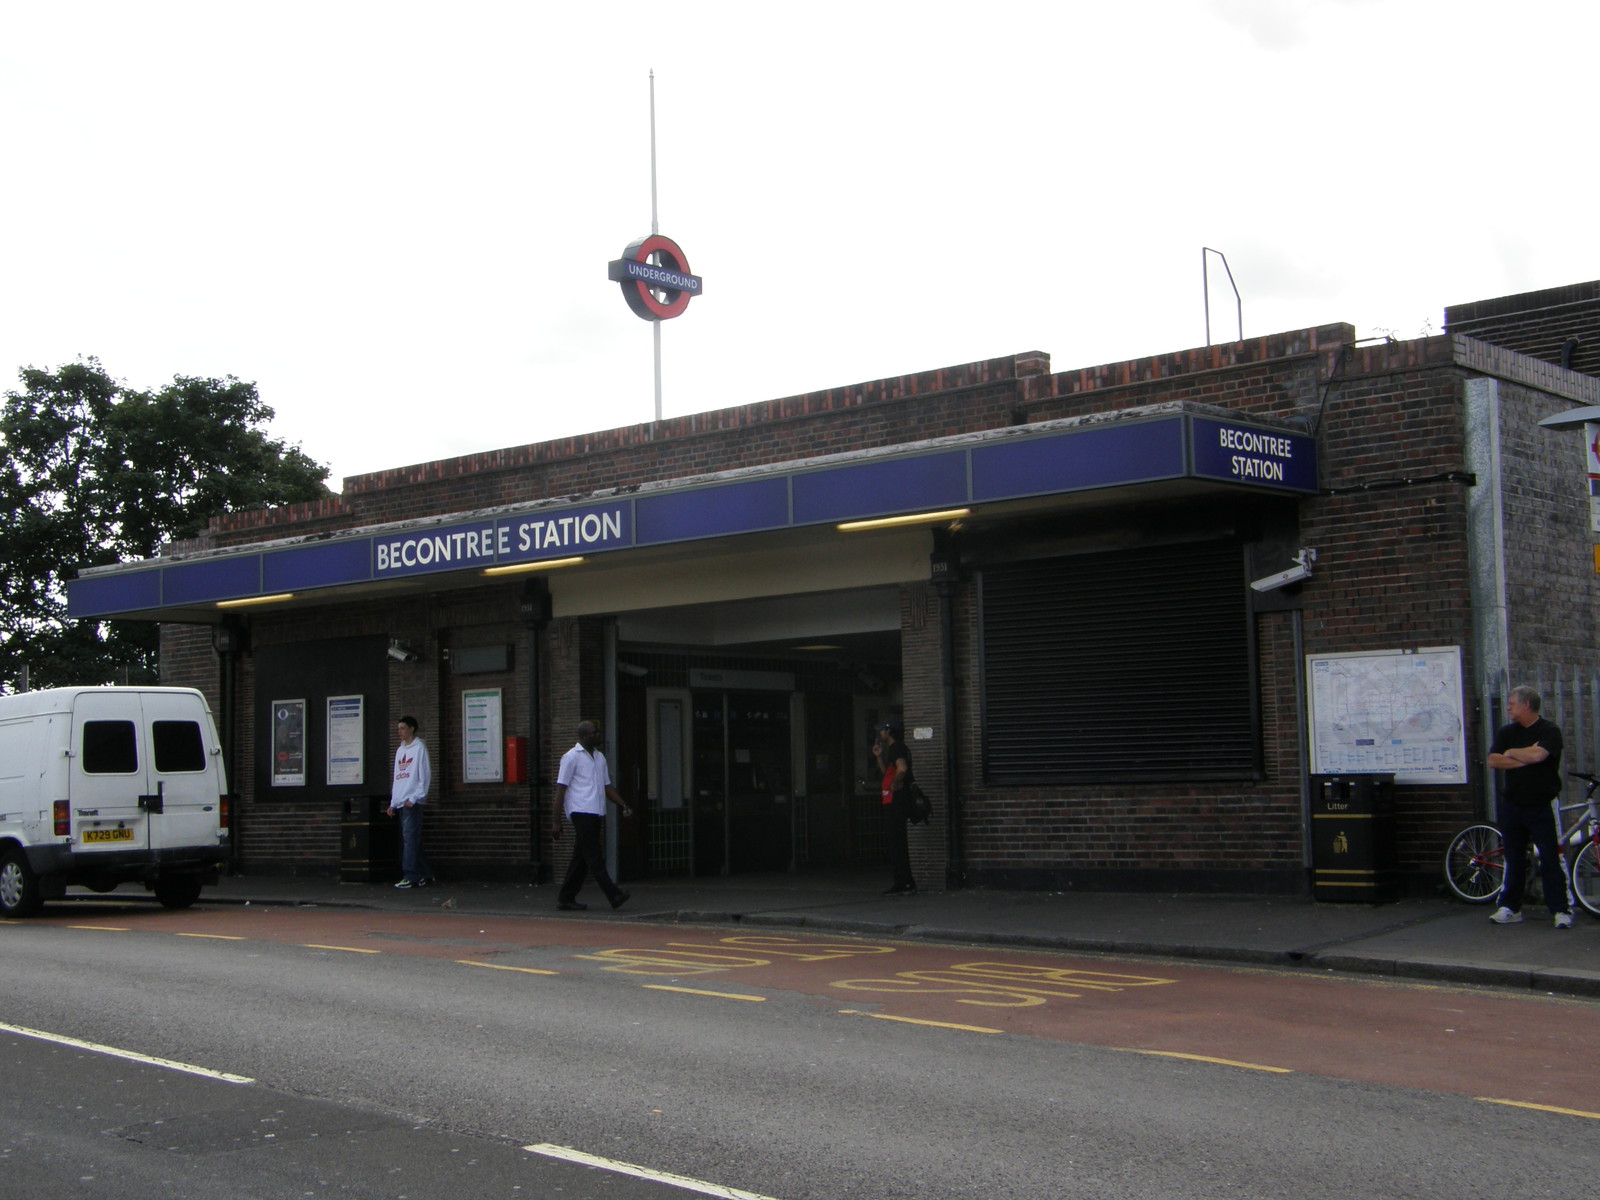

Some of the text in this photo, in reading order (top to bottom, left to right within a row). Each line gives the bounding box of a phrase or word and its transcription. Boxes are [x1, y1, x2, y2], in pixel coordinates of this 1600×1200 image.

[629, 264, 698, 289] UNDERGROUND
[1220, 428, 1292, 458] BECONTREE
[1231, 455, 1283, 481] STATION
[377, 510, 621, 571] BECONTREE STATION
[1327, 802, 1349, 811] Litter
[86, 829, 130, 841] K729 GNU
